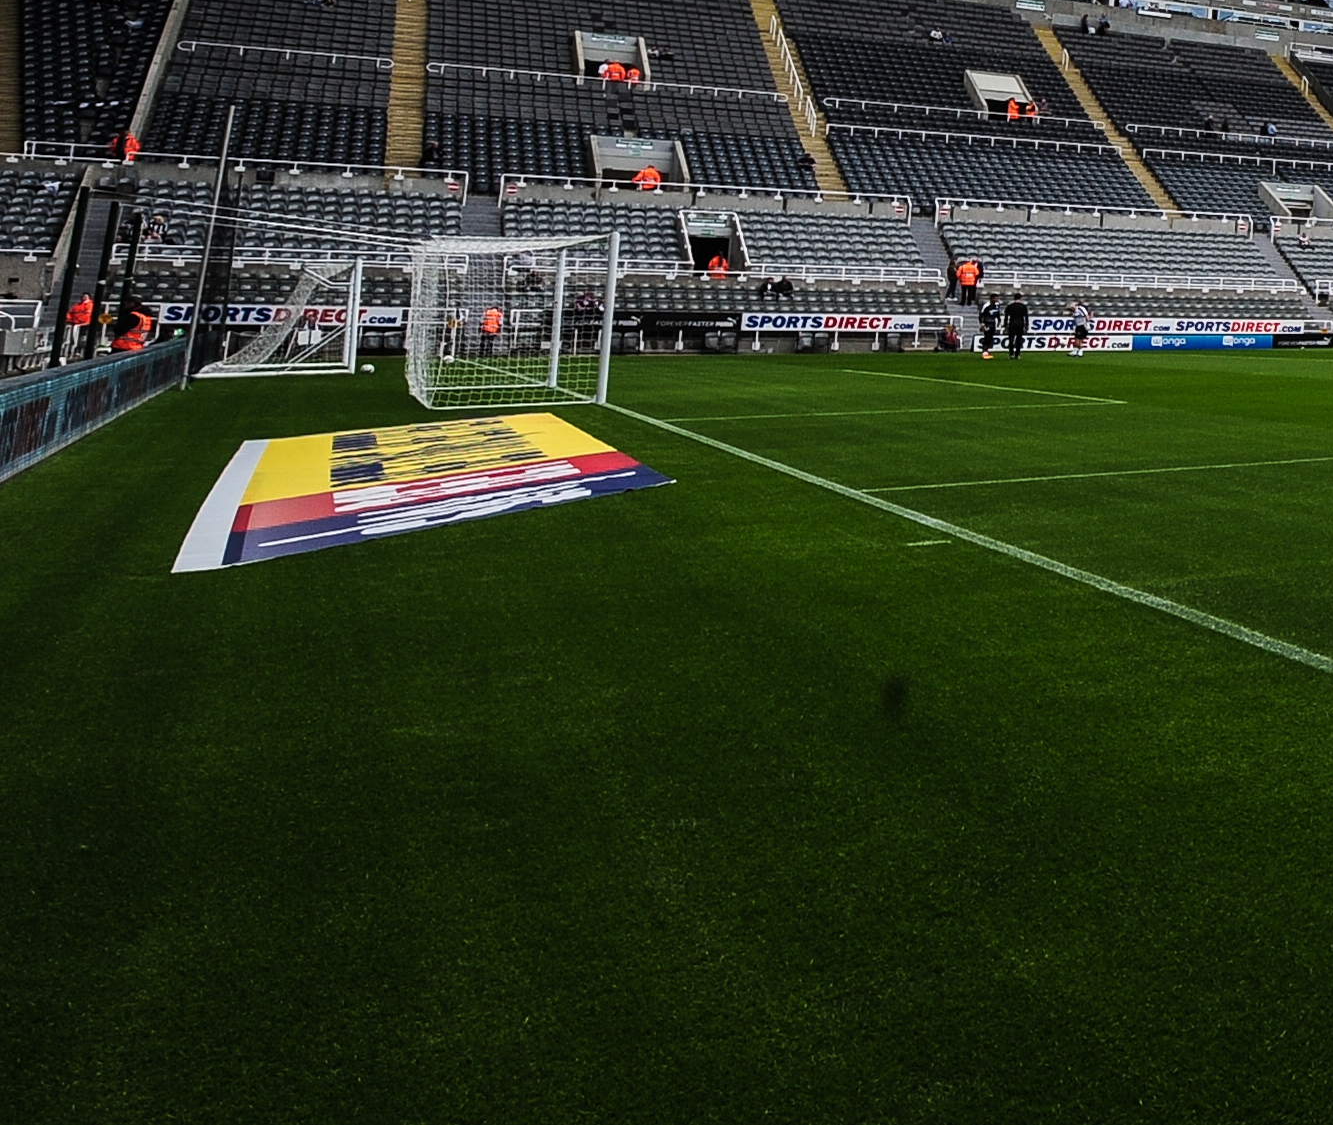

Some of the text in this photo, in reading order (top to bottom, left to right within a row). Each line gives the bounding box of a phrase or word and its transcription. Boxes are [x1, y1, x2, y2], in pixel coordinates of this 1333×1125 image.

[746, 315, 915, 330] SPORTSDIRECT.COM
[1031, 319, 1171, 332] SPORSDIRECT.COM
[1175, 321, 1302, 333] SPORTSDIRECT.COM
